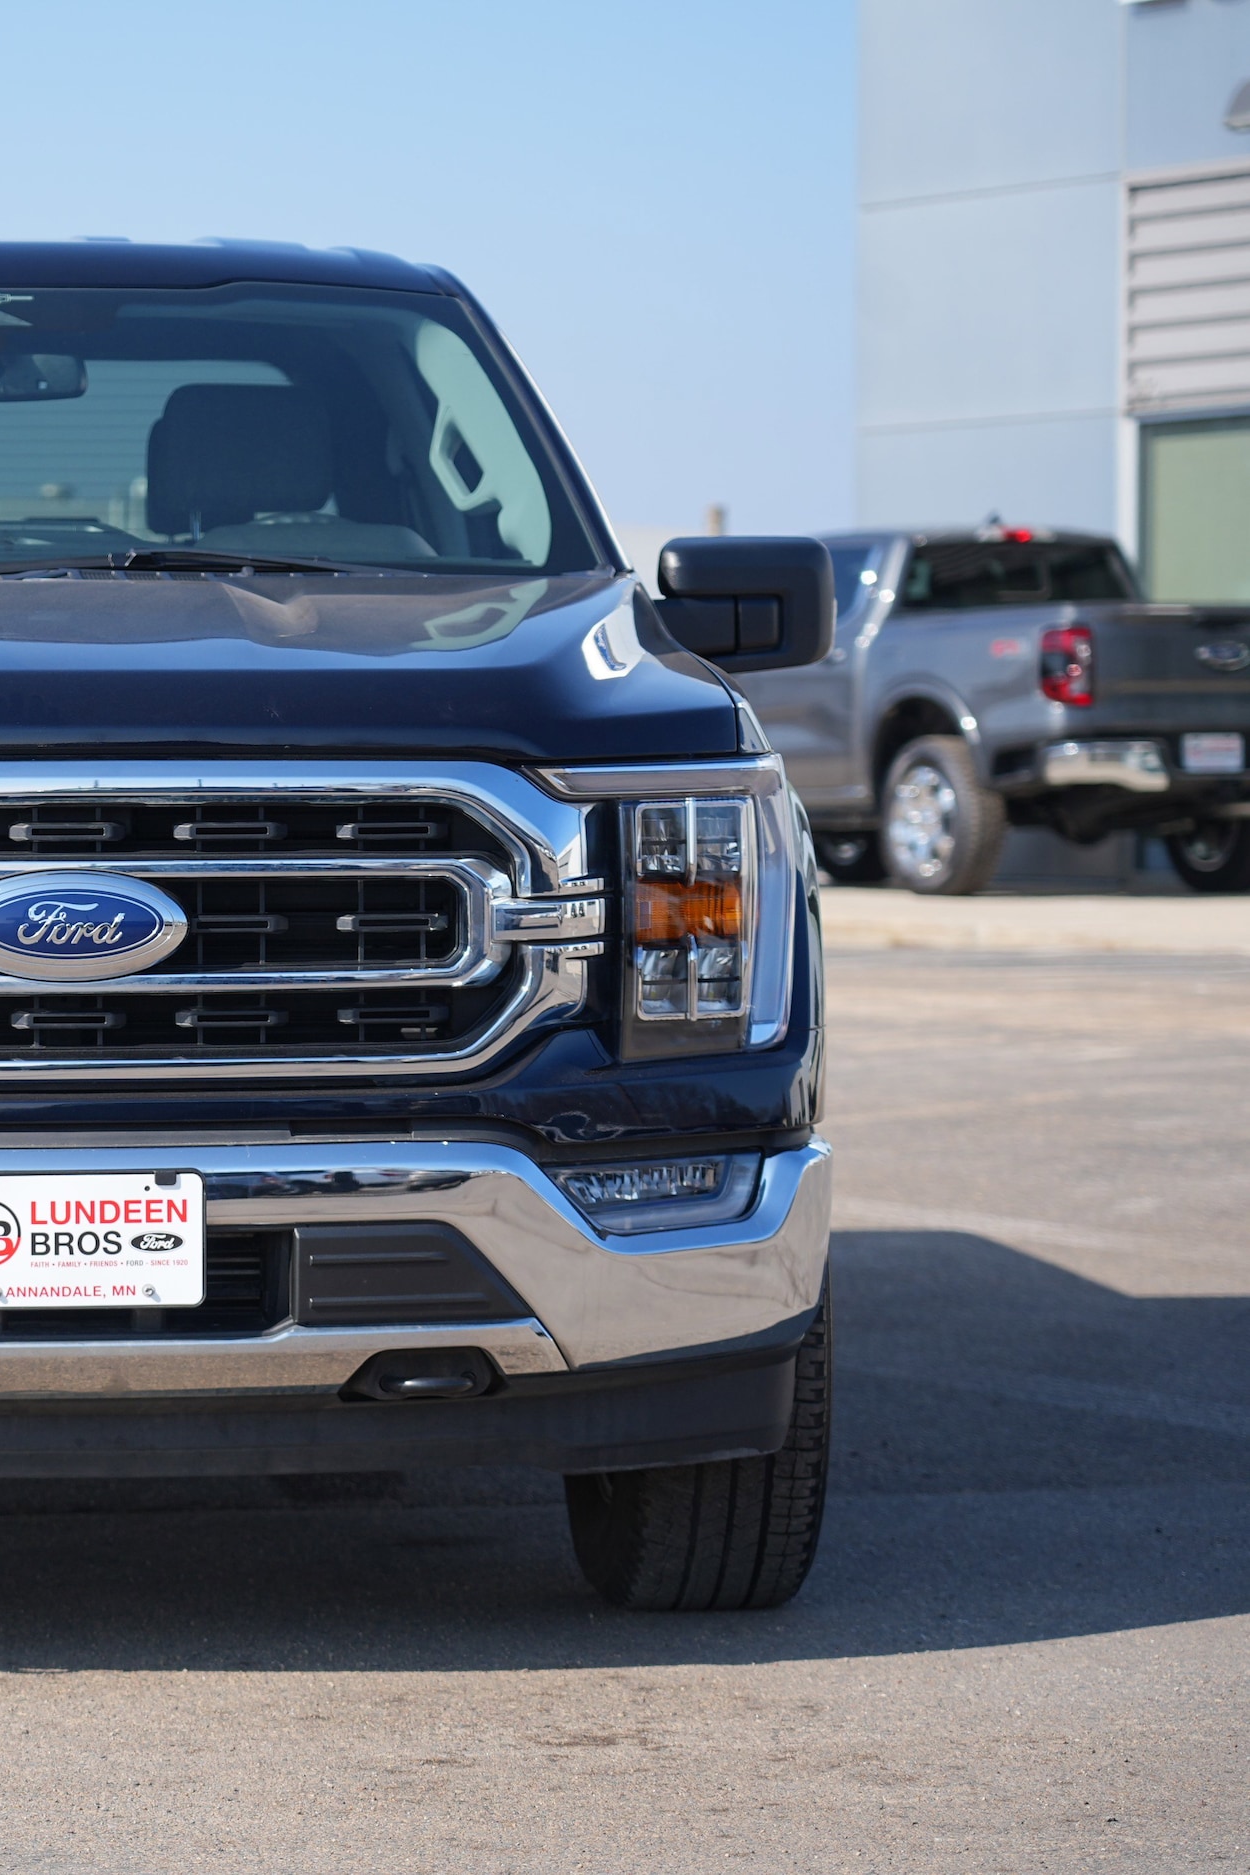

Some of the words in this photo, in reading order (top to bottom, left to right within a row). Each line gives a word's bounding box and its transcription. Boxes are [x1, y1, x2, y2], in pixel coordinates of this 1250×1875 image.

[16, 900, 126, 945] Ford
[30, 1198, 188, 1225] LUNDEEN
[30, 1230, 123, 1256] BROS
[30, 1260, 50, 1268] FAITH
[57, 1260, 82, 1268] FAMILY
[89, 1260, 118, 1268] FRIENDS
[125, 1259, 144, 1267] FORD
[5, 1285, 107, 1299] ANNANDALE,
[112, 1284, 137, 1297] MN
